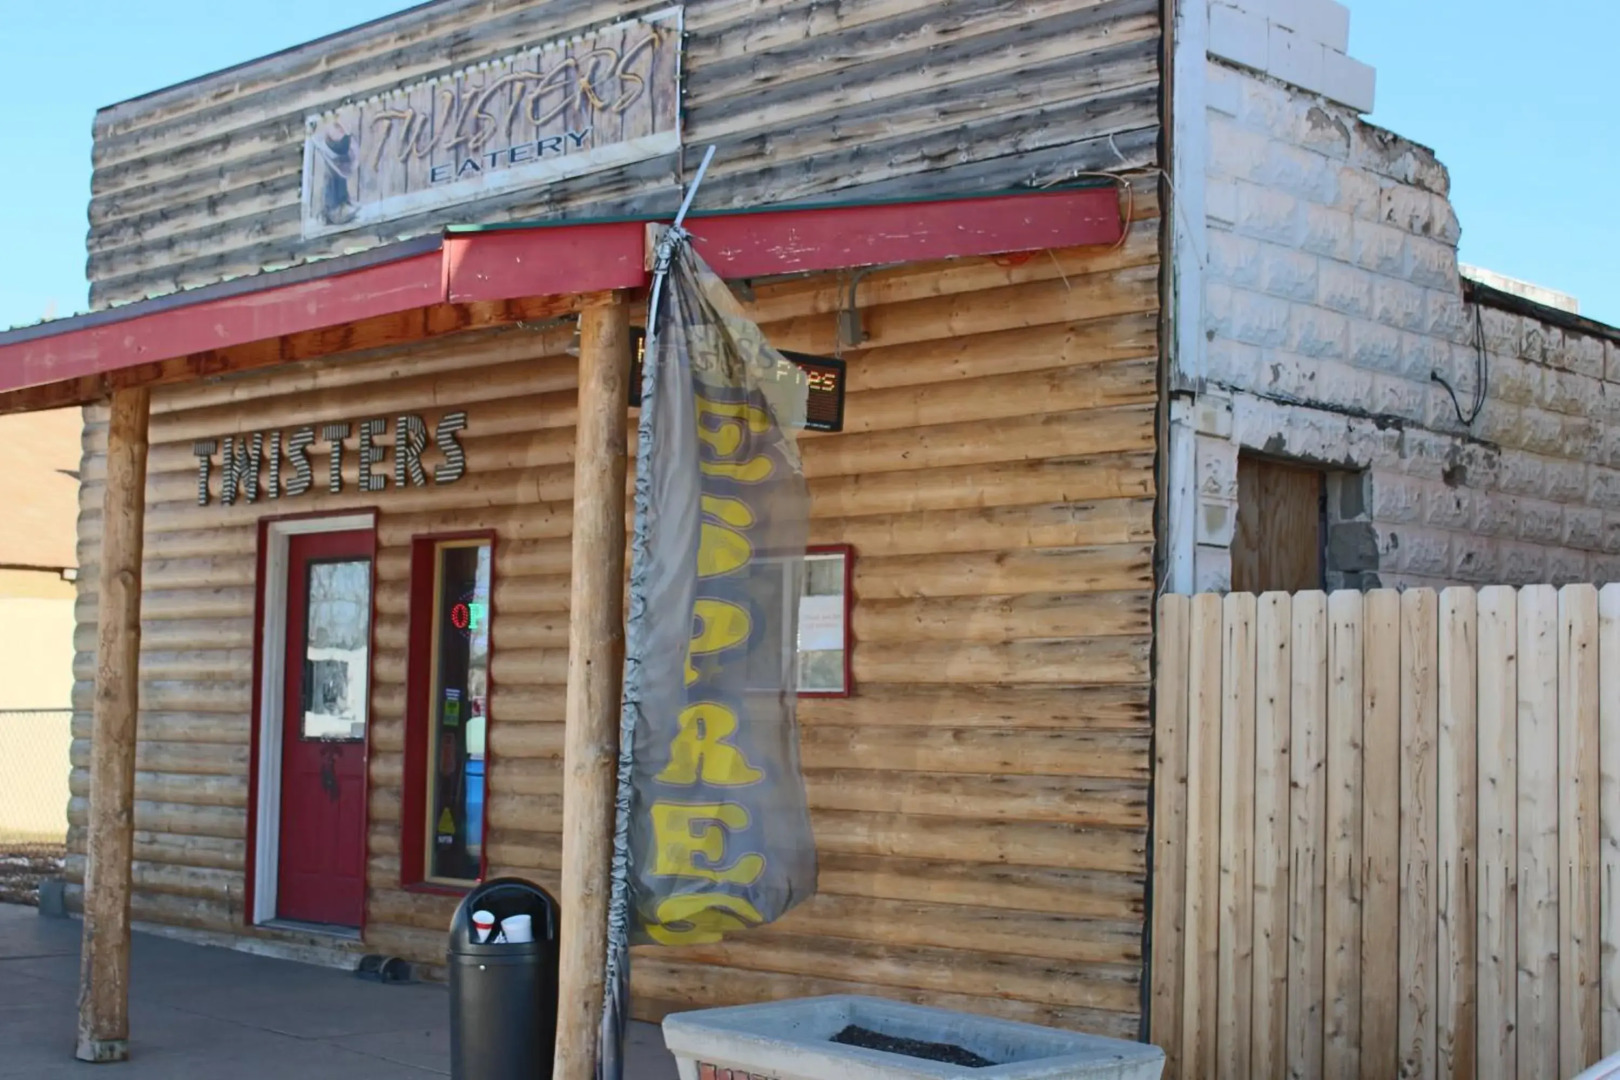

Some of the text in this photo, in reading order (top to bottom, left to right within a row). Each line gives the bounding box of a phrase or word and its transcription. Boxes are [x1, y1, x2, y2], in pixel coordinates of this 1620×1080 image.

[370, 31, 663, 171] TWISTERS
[430, 127, 593, 183] EATERY
[194, 411, 467, 506] TWISTERS
